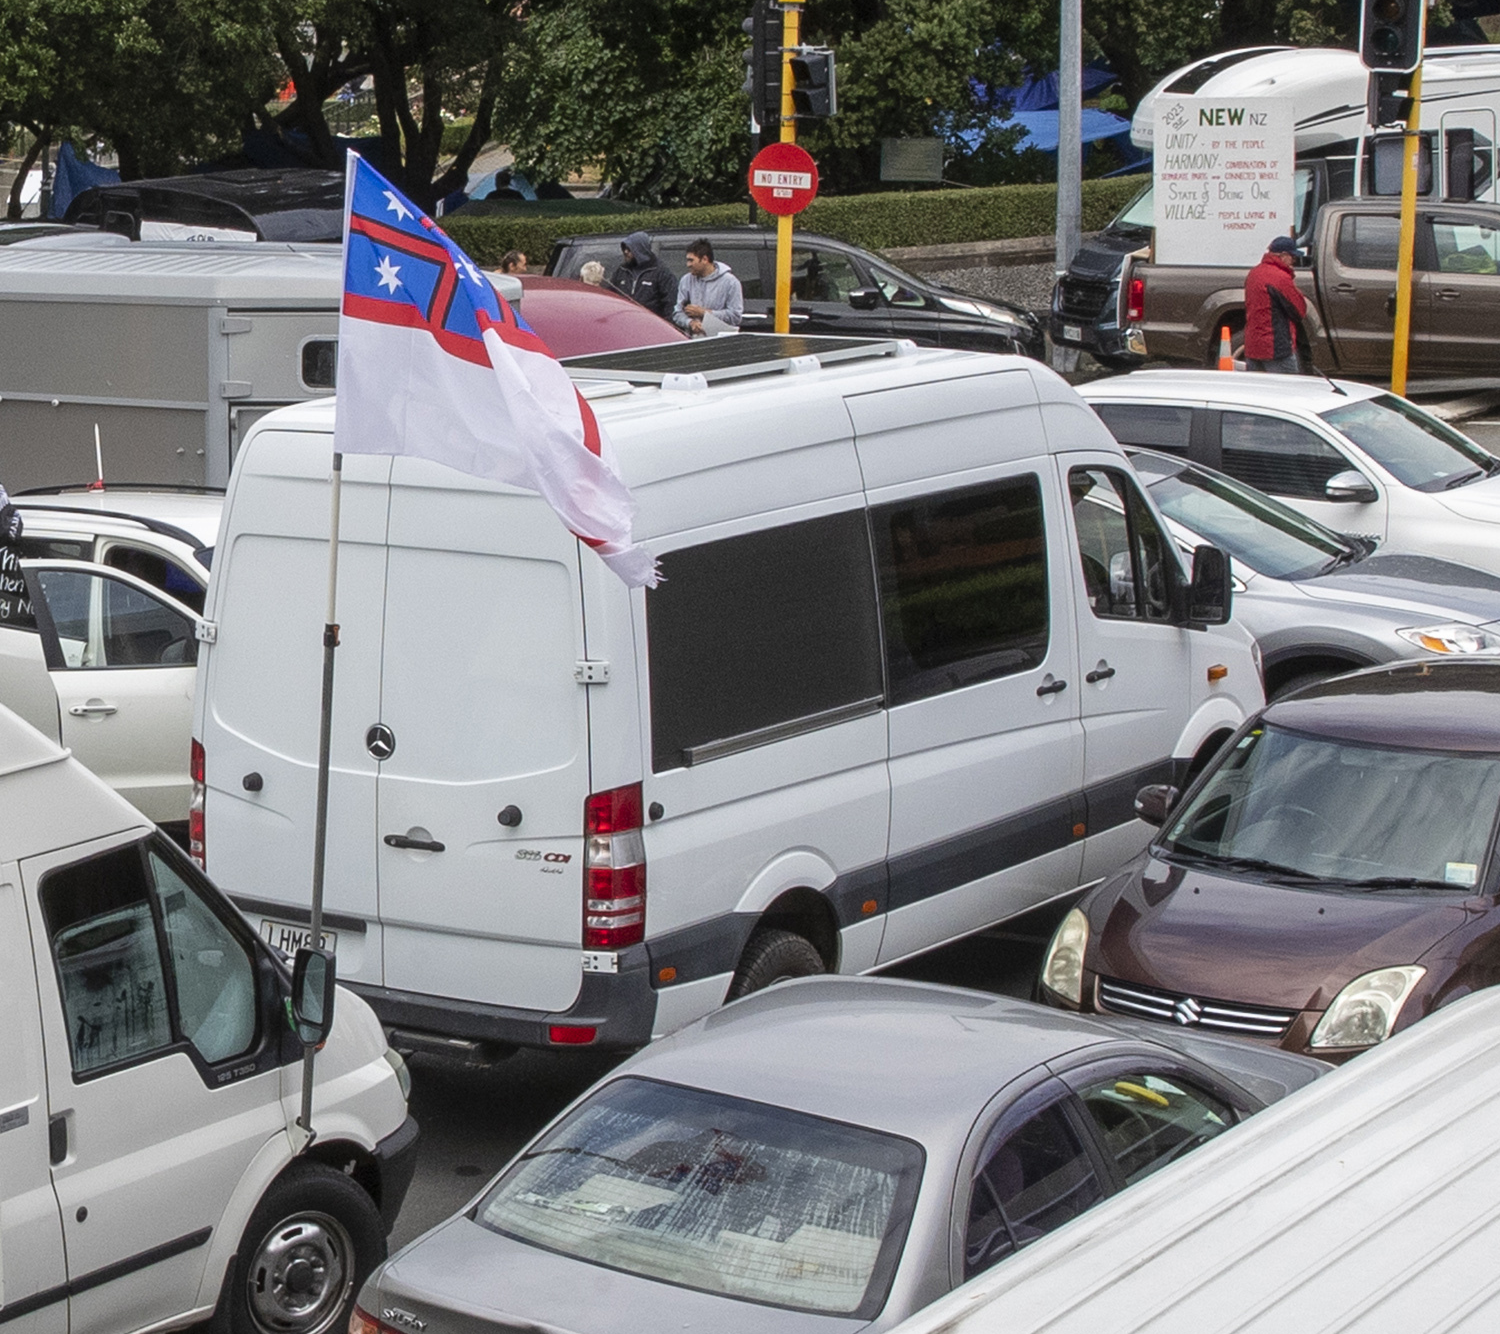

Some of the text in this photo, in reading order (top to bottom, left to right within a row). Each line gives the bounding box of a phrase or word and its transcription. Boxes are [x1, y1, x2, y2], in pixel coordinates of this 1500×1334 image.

[1162, 103, 1184, 125] 2023
[1199, 108, 1268, 126] NEW NZ
[1165, 134, 1198, 149] UNITY
[1225, 140, 1237, 149] THE
[1242, 140, 1265, 149] PEOPLE
[1225, 161, 1267, 169] COMBINATION
[762, 174, 803, 185] NO ENTRY
[1218, 211, 1240, 219] PEOPLE
